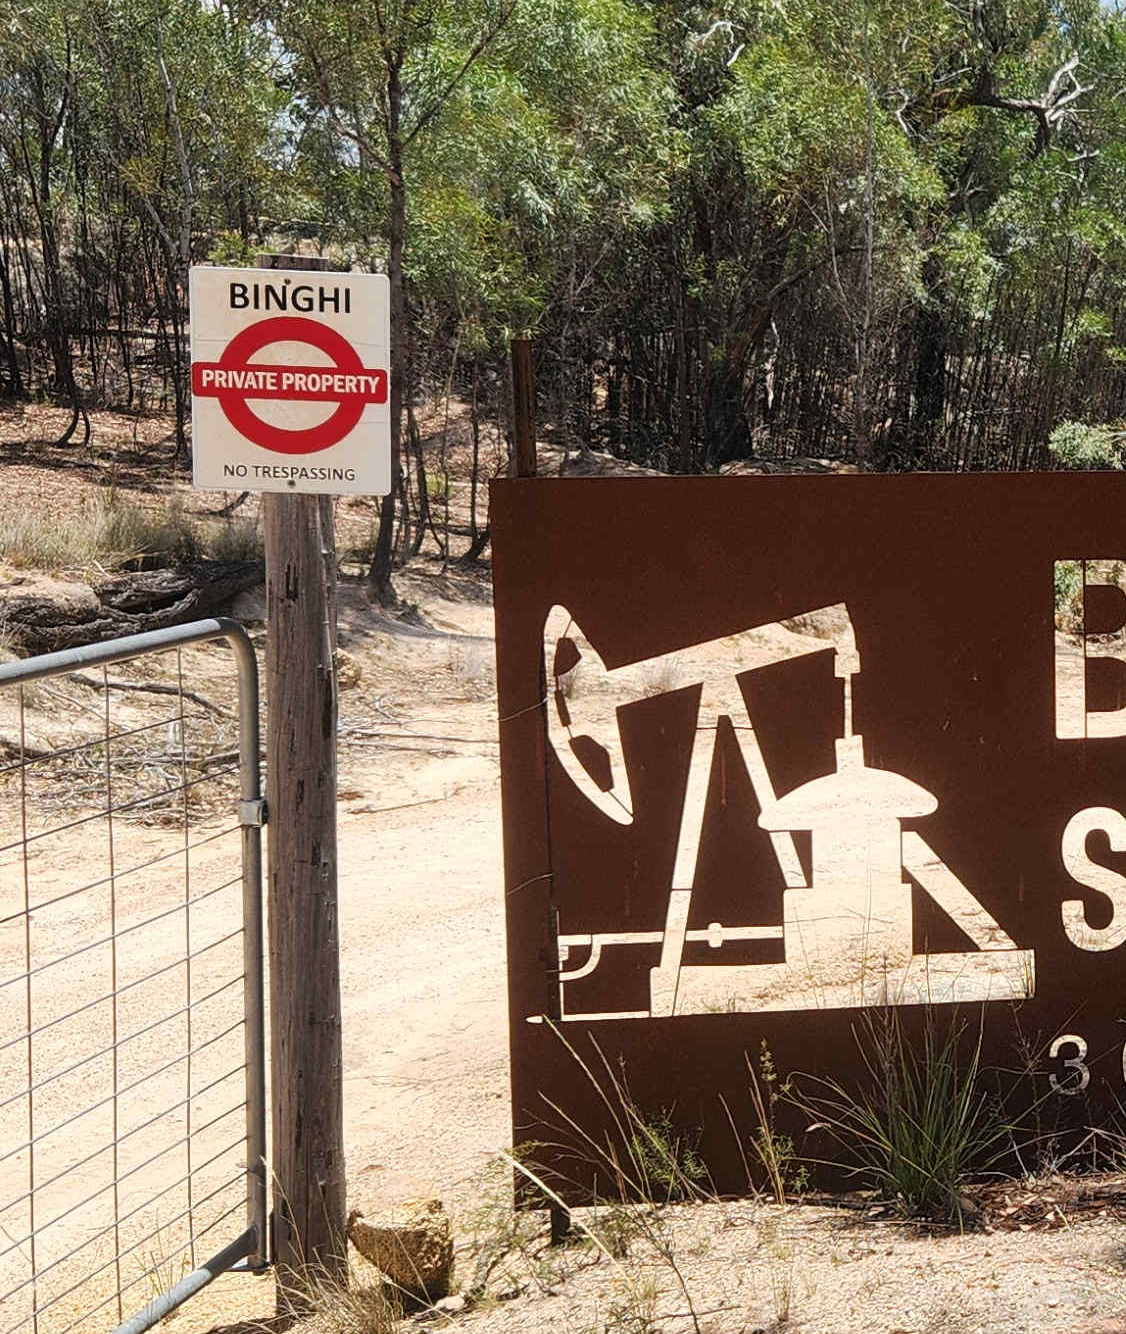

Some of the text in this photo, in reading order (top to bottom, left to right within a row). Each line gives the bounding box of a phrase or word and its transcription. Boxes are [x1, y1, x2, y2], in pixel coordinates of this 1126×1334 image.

[229, 282, 351, 314] BINGHI
[201, 369, 380, 395] PRIVATE PROPERTY
[223, 464, 356, 482] NO TRESPASSING
